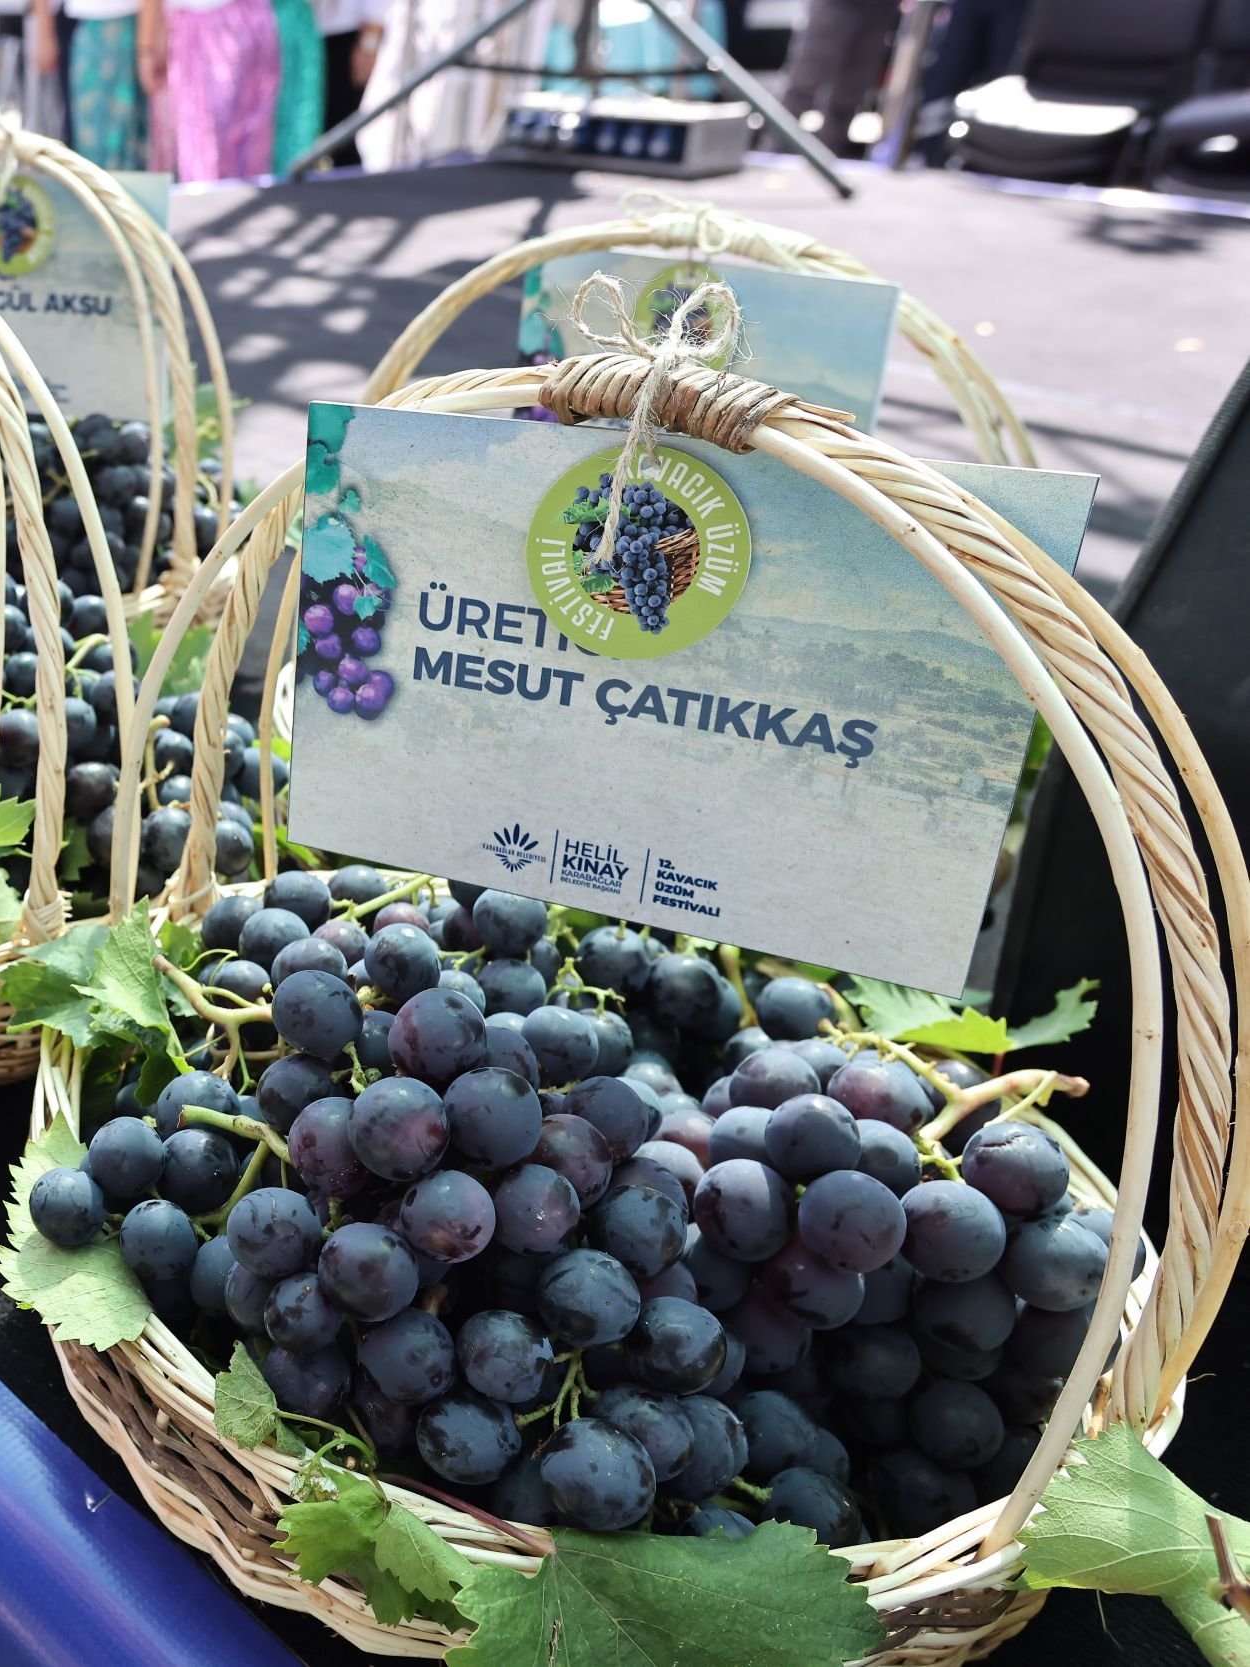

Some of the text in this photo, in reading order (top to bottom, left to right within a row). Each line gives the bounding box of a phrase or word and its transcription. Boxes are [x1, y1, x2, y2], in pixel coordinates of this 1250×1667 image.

[695, 522, 741, 597] ÜZÜM
[536, 537, 615, 641] FESTİVALİ
[418, 581, 621, 659] ÜRET
[412, 646, 879, 769] MESUT ÇATIKKAŞ
[564, 838, 624, 865] HELİL
[658, 858, 676, 870] 12.
[562, 854, 630, 881] KINAY
[656, 869, 718, 891] KAVACIK
[655, 880, 695, 899] ÜZÜM
[652, 894, 721, 918] FESTİVALİ
